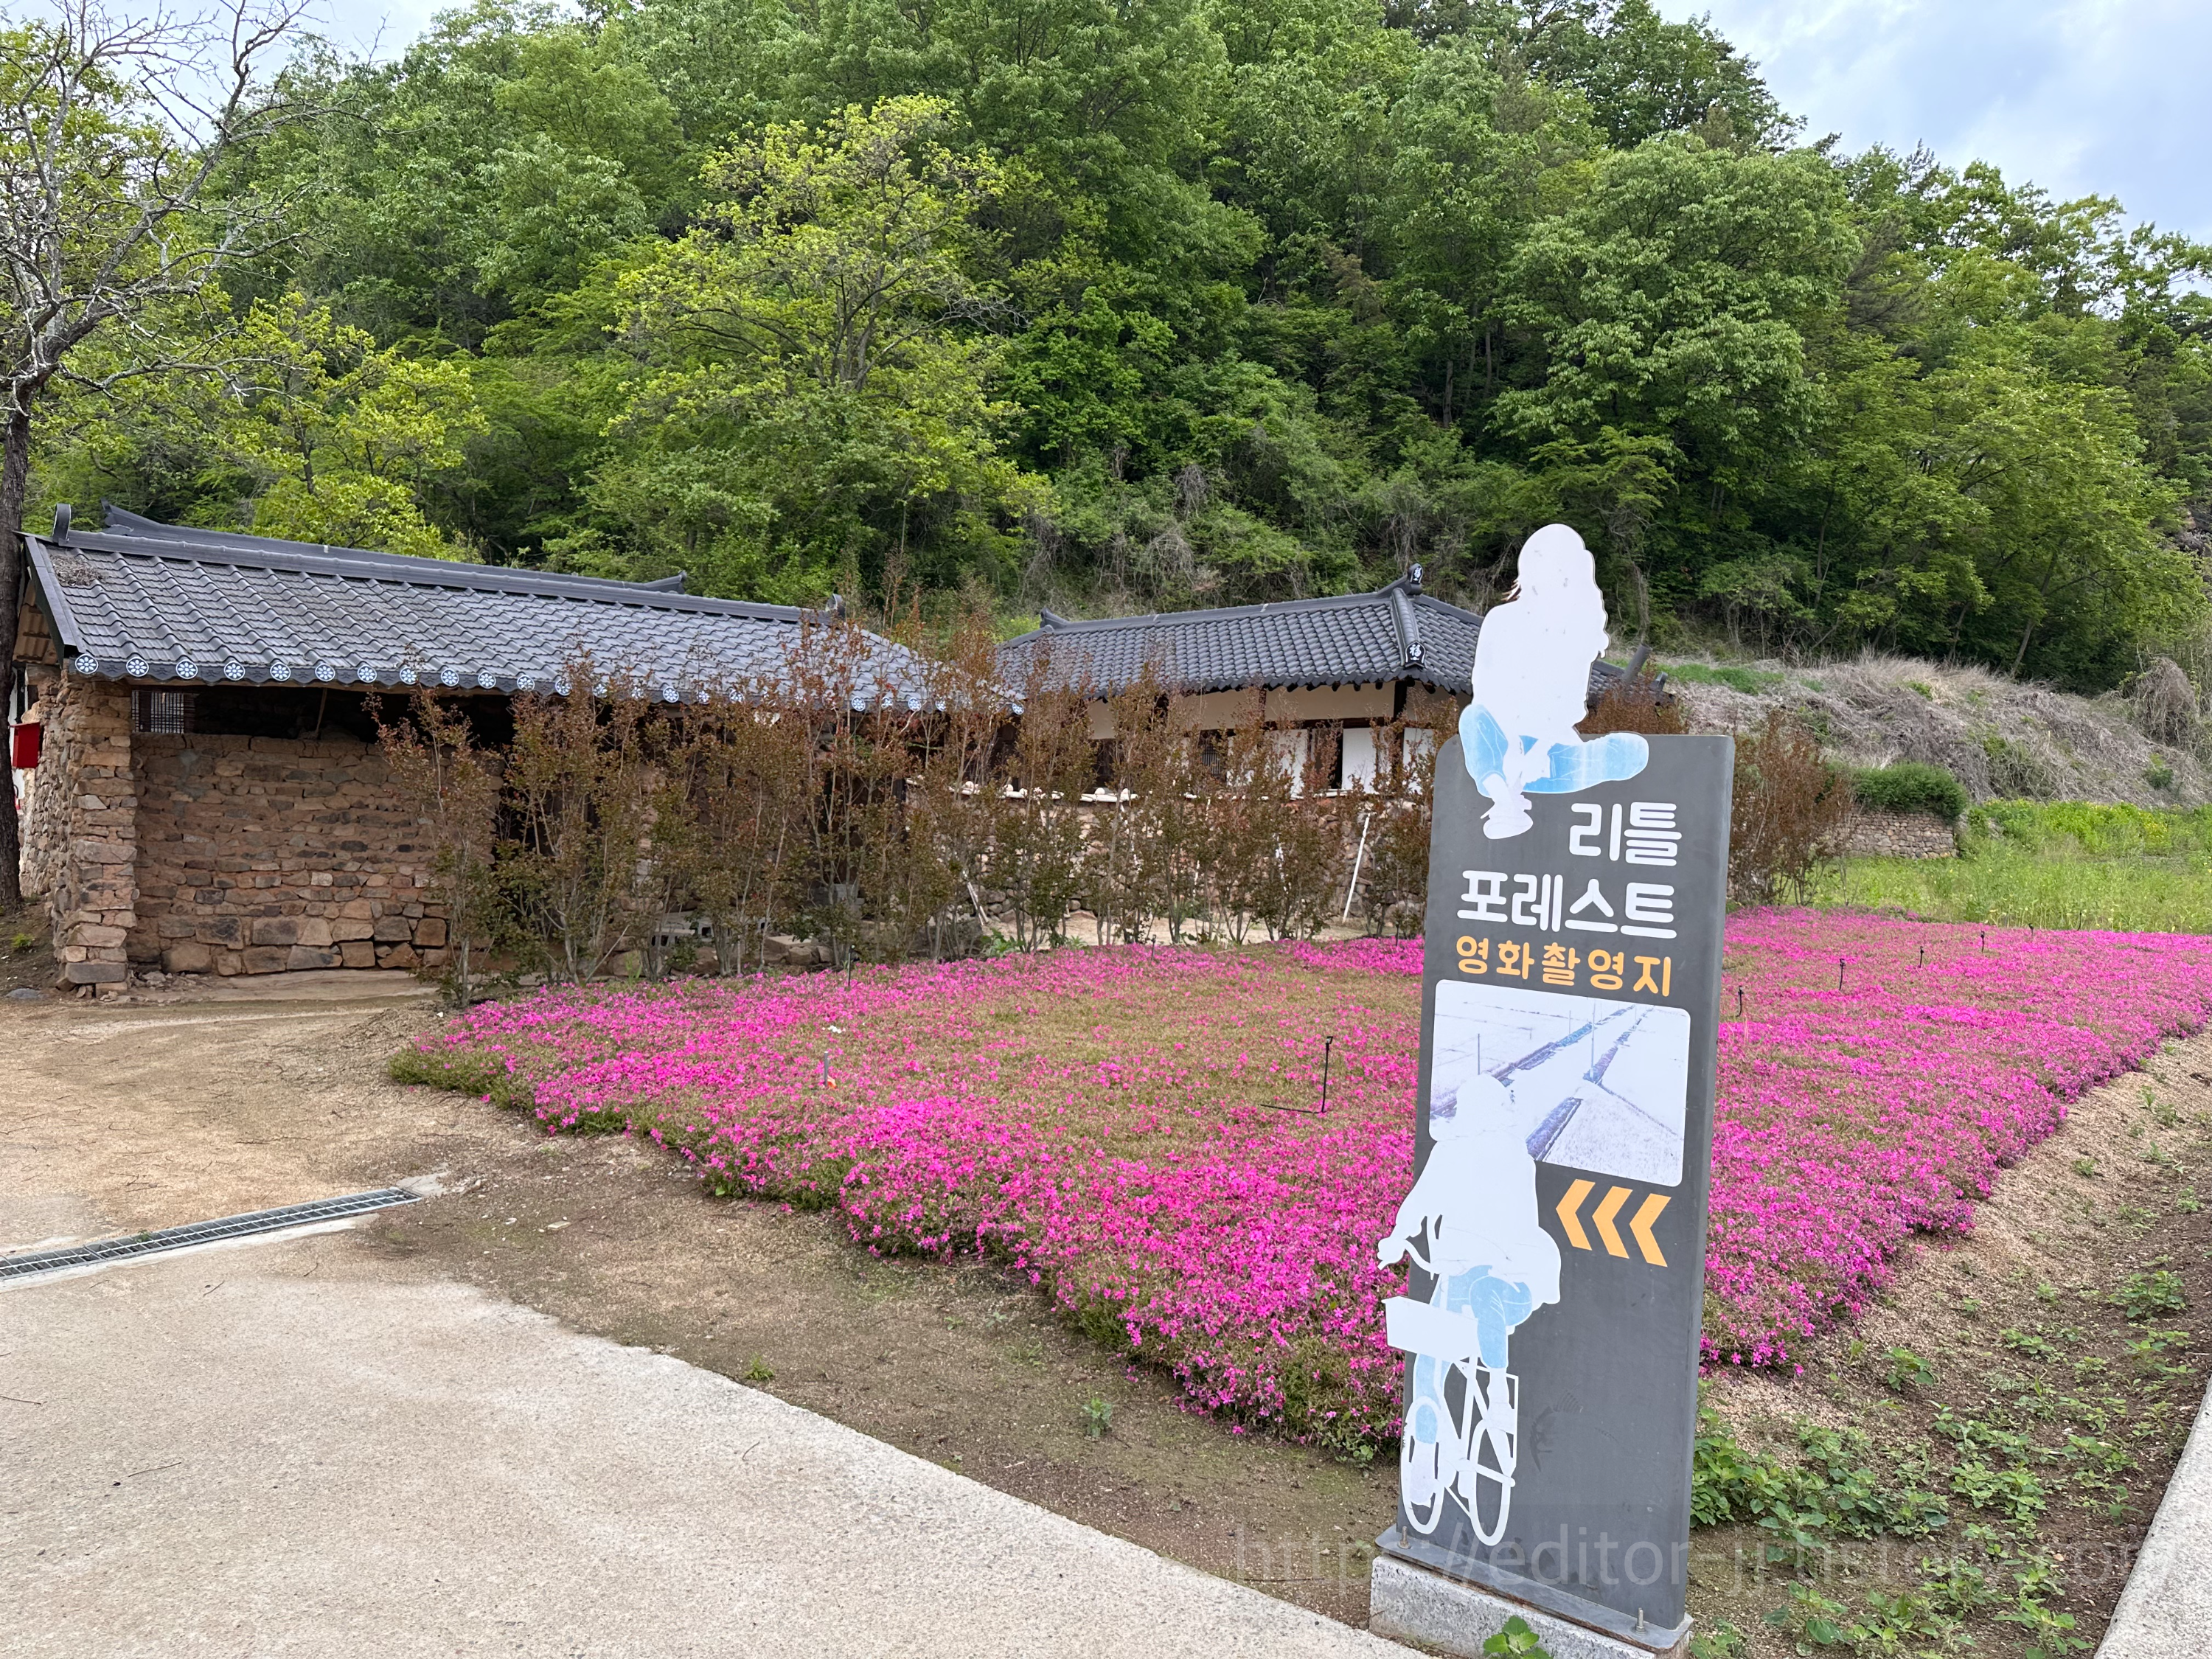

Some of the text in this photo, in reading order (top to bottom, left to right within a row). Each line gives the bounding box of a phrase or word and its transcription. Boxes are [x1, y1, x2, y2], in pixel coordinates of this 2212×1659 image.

[1409, 644, 1422, 657] 福
[1569, 801, 1682, 866] 리틀
[1456, 870, 1677, 939] 포레스트
